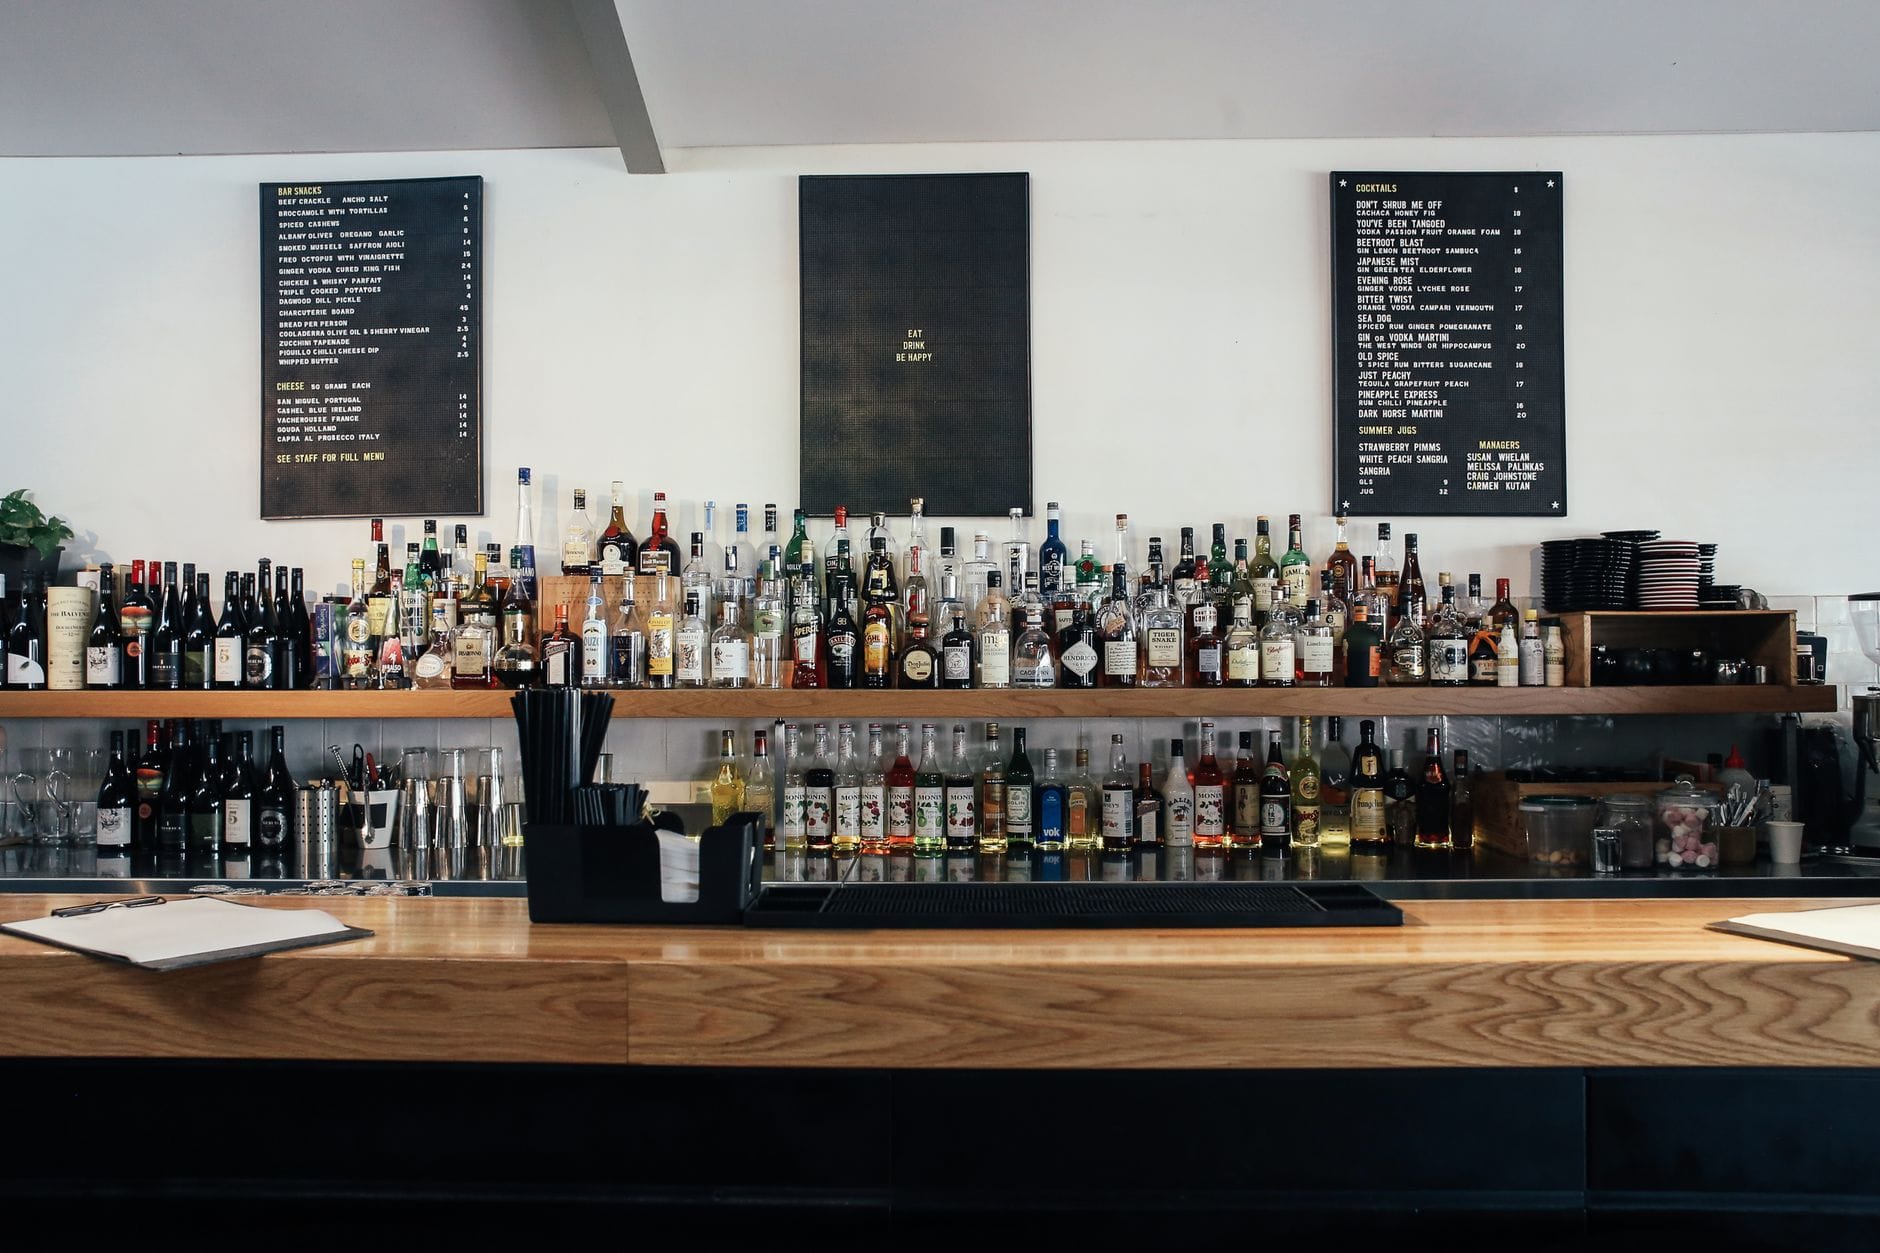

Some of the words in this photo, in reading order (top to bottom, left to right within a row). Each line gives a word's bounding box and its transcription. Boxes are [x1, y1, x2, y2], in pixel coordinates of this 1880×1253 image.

[278, 187, 293, 196] BAR
[294, 186, 322, 196] SNACKS
[1356, 184, 1397, 193] COCKTAILS
[298, 197, 331, 205] CRACKLE
[1356, 200, 1378, 209] DON'T
[1382, 200, 1407, 209] SHRUB
[1411, 200, 1423, 209] ME
[1427, 200, 1442, 209] OFF
[279, 221, 304, 229] SPICED
[308, 220, 340, 228] CASHEWS
[1356, 219, 1383, 228] YOU'VE
[1387, 219, 1407, 228] BEEN
[1411, 219, 1446, 228] TANGOED
[278, 244, 307, 252] SMOKED
[310, 243, 342, 251] MUSSELS
[349, 242, 382, 250] SAFFRON
[385, 241, 405, 249] AIOLI
[1356, 238, 1395, 247] BEETROOT
[1399, 238, 1424, 247] BLAST
[1357, 257, 1396, 266] JAPANESE
[1400, 257, 1419, 266] MIST
[1357, 276, 1389, 285] EVENING
[1393, 276, 1413, 285] ROSE
[310, 287, 339, 295] COOKED
[345, 286, 381, 294] POTATOES
[1357, 295, 1384, 304] BITTER
[1388, 295, 1413, 304] TWIST
[279, 309, 327, 317] CHARCUTERIE
[1357, 314, 1373, 323] SEA
[1376, 314, 1392, 323] DOG
[908, 329, 922, 338] EAT
[1357, 333, 1370, 342] GIN
[1388, 333, 1414, 342] VODKA
[1418, 333, 1449, 342] MARTINI
[313, 338, 350, 346] TAPENADE
[903, 341, 925, 350] DRINK
[312, 348, 337, 356] CHILLI
[337, 347, 366, 355] CHEESE
[896, 353, 906, 362] BE
[908, 353, 932, 362] HAPPY
[1357, 352, 1373, 361] OLD
[1377, 352, 1399, 361] SPICE
[1358, 371, 1378, 380] JUST
[1382, 371, 1412, 380] PEACHY
[276, 382, 305, 391] CHEESE
[1358, 390, 1400, 399] PINEAPPLE
[1404, 390, 1438, 399] EXPRESS
[1358, 409, 1378, 418] DARK
[1382, 409, 1407, 418] HORSE
[1411, 409, 1443, 418] MARTINI
[1358, 426, 1393, 435] SUMMER
[1397, 426, 1417, 435] JUGS
[277, 435, 300, 443] CAPRA
[317, 434, 355, 442] PROSECCO
[358, 433, 380, 441] ITALY
[1358, 442, 1410, 452] STRAWBERRY
[1414, 443, 1441, 452] PIMMS
[1479, 440, 1520, 450] MANAGERS
[277, 454, 291, 464] SEE
[295, 453, 318, 463] STAFF
[322, 453, 337, 462] FOR
[340, 453, 359, 462] FULL
[363, 452, 385, 461] MENU
[1359, 454, 1383, 464] WHITE
[1387, 454, 1412, 464] PEACH
[1416, 455, 1448, 464] SANGRIA
[1467, 453, 1492, 462] SUSAN
[1498, 453, 1530, 462] WHELAN
[1467, 462, 1501, 471] MELISSA
[1507, 462, 1545, 471] PALINKAS
[1359, 467, 1391, 476] SANGRIA
[1466, 472, 1489, 481] CRAIG
[1493, 472, 1537, 481] JOHNSTONE
[1467, 481, 1499, 490] CARMEN
[1505, 481, 1530, 490] KUTAN
[1043, 827, 1060, 837] vok
